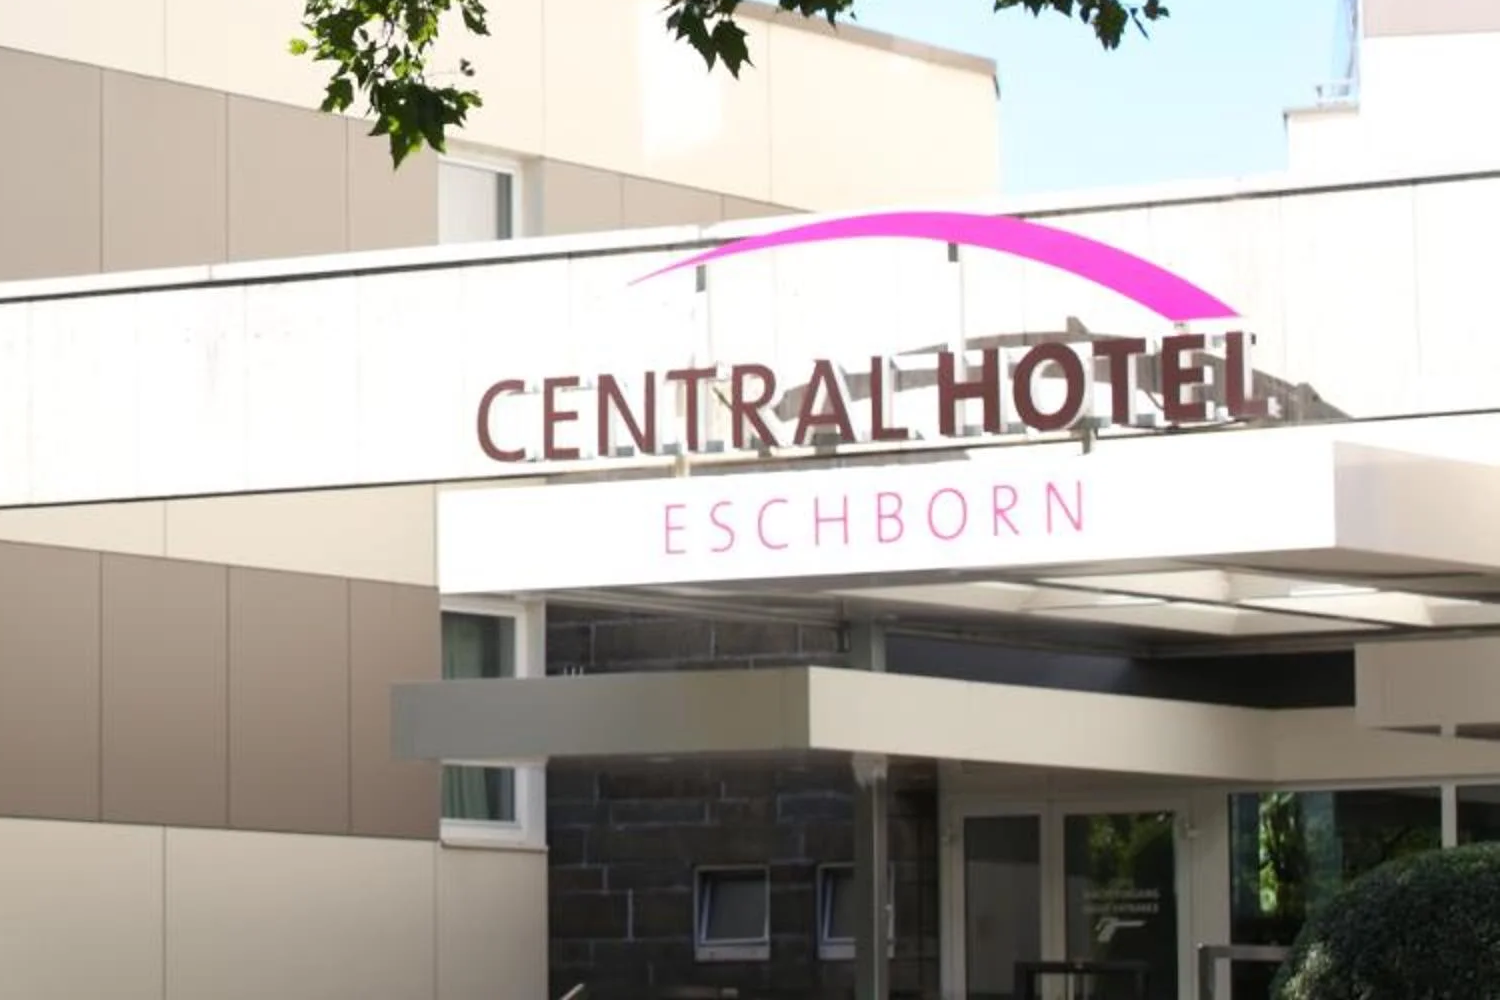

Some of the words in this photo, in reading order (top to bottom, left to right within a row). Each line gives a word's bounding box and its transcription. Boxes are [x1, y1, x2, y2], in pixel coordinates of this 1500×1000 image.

[476, 355, 908, 462] CENTRAL
[938, 331, 1269, 437] HOTEL
[664, 480, 1083, 555] ESCHBORN
